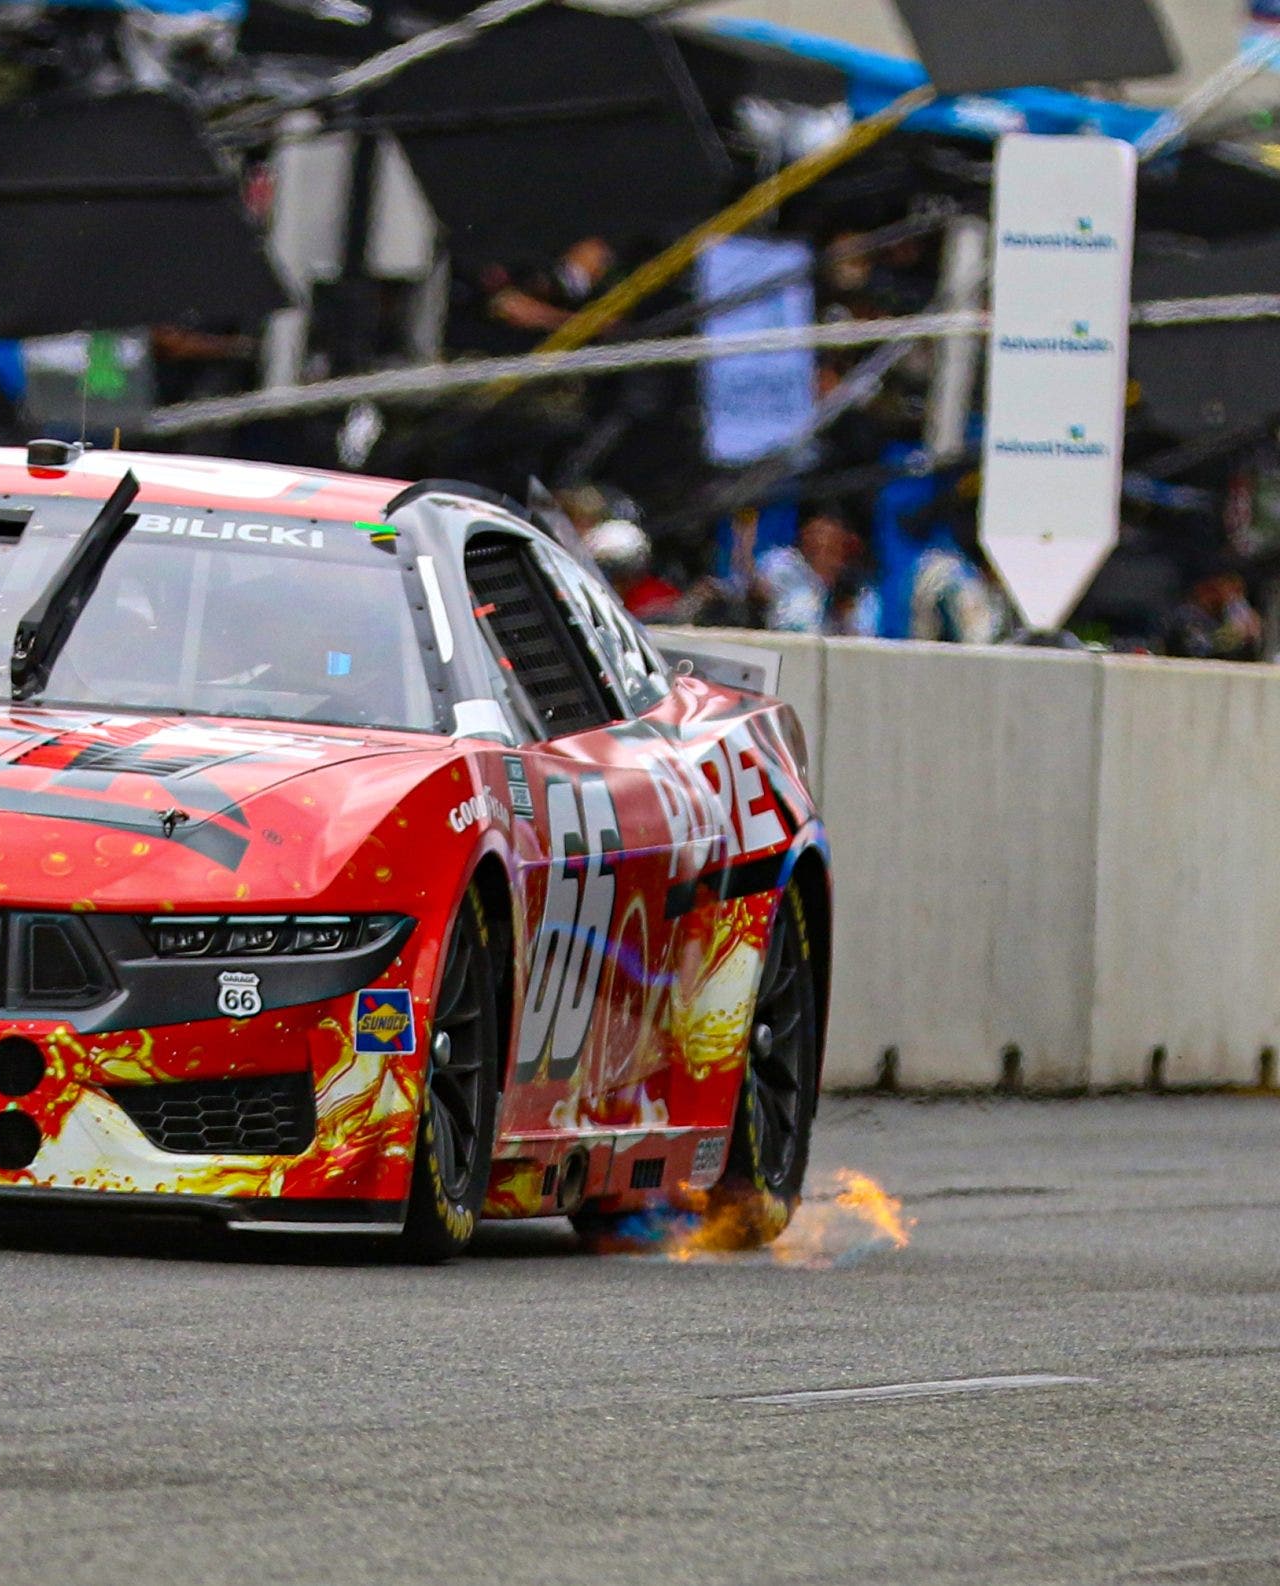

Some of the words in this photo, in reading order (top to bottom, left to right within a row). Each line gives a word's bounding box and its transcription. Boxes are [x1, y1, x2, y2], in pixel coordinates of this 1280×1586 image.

[133, 513, 324, 549] BILICKI
[517, 777, 622, 1080] 66
[225, 989, 256, 1011] 66
[360, 1014, 407, 1032] SUNOCO
